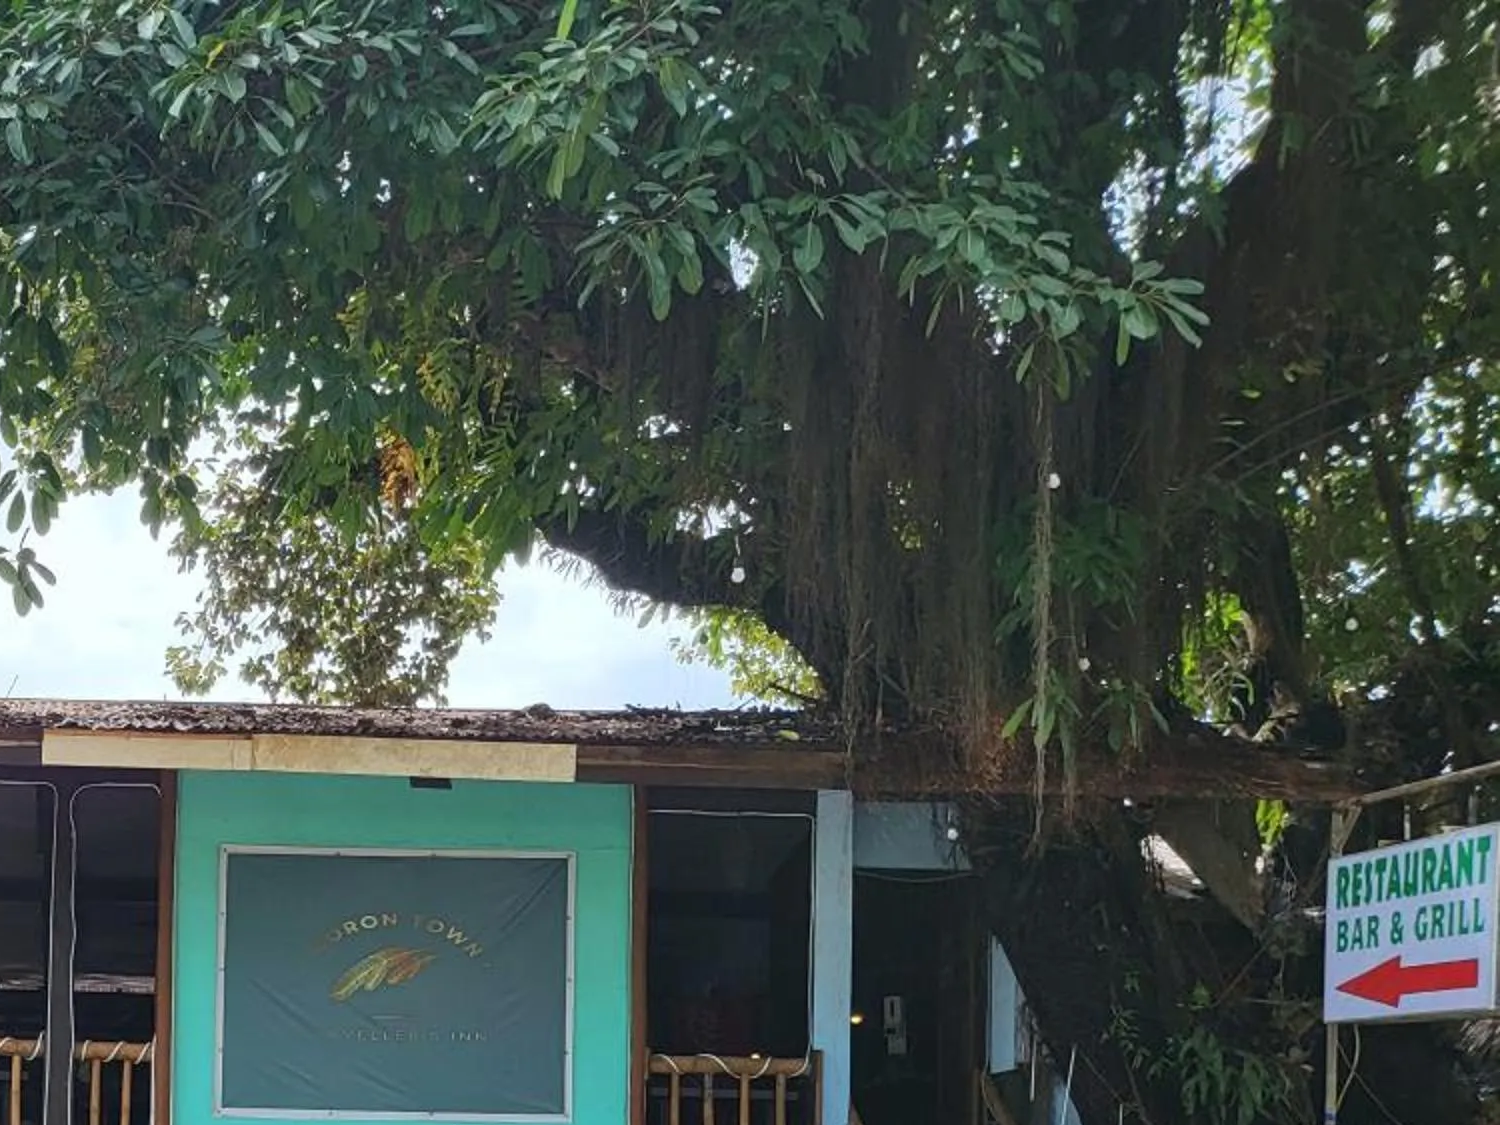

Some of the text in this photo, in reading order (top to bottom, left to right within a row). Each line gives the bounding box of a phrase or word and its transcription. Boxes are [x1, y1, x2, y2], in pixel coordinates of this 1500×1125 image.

[1335, 835, 1492, 910] RESTAURANT
[311, 912, 398, 953] ORON
[1336, 898, 1486, 953] BAR & GRILL
